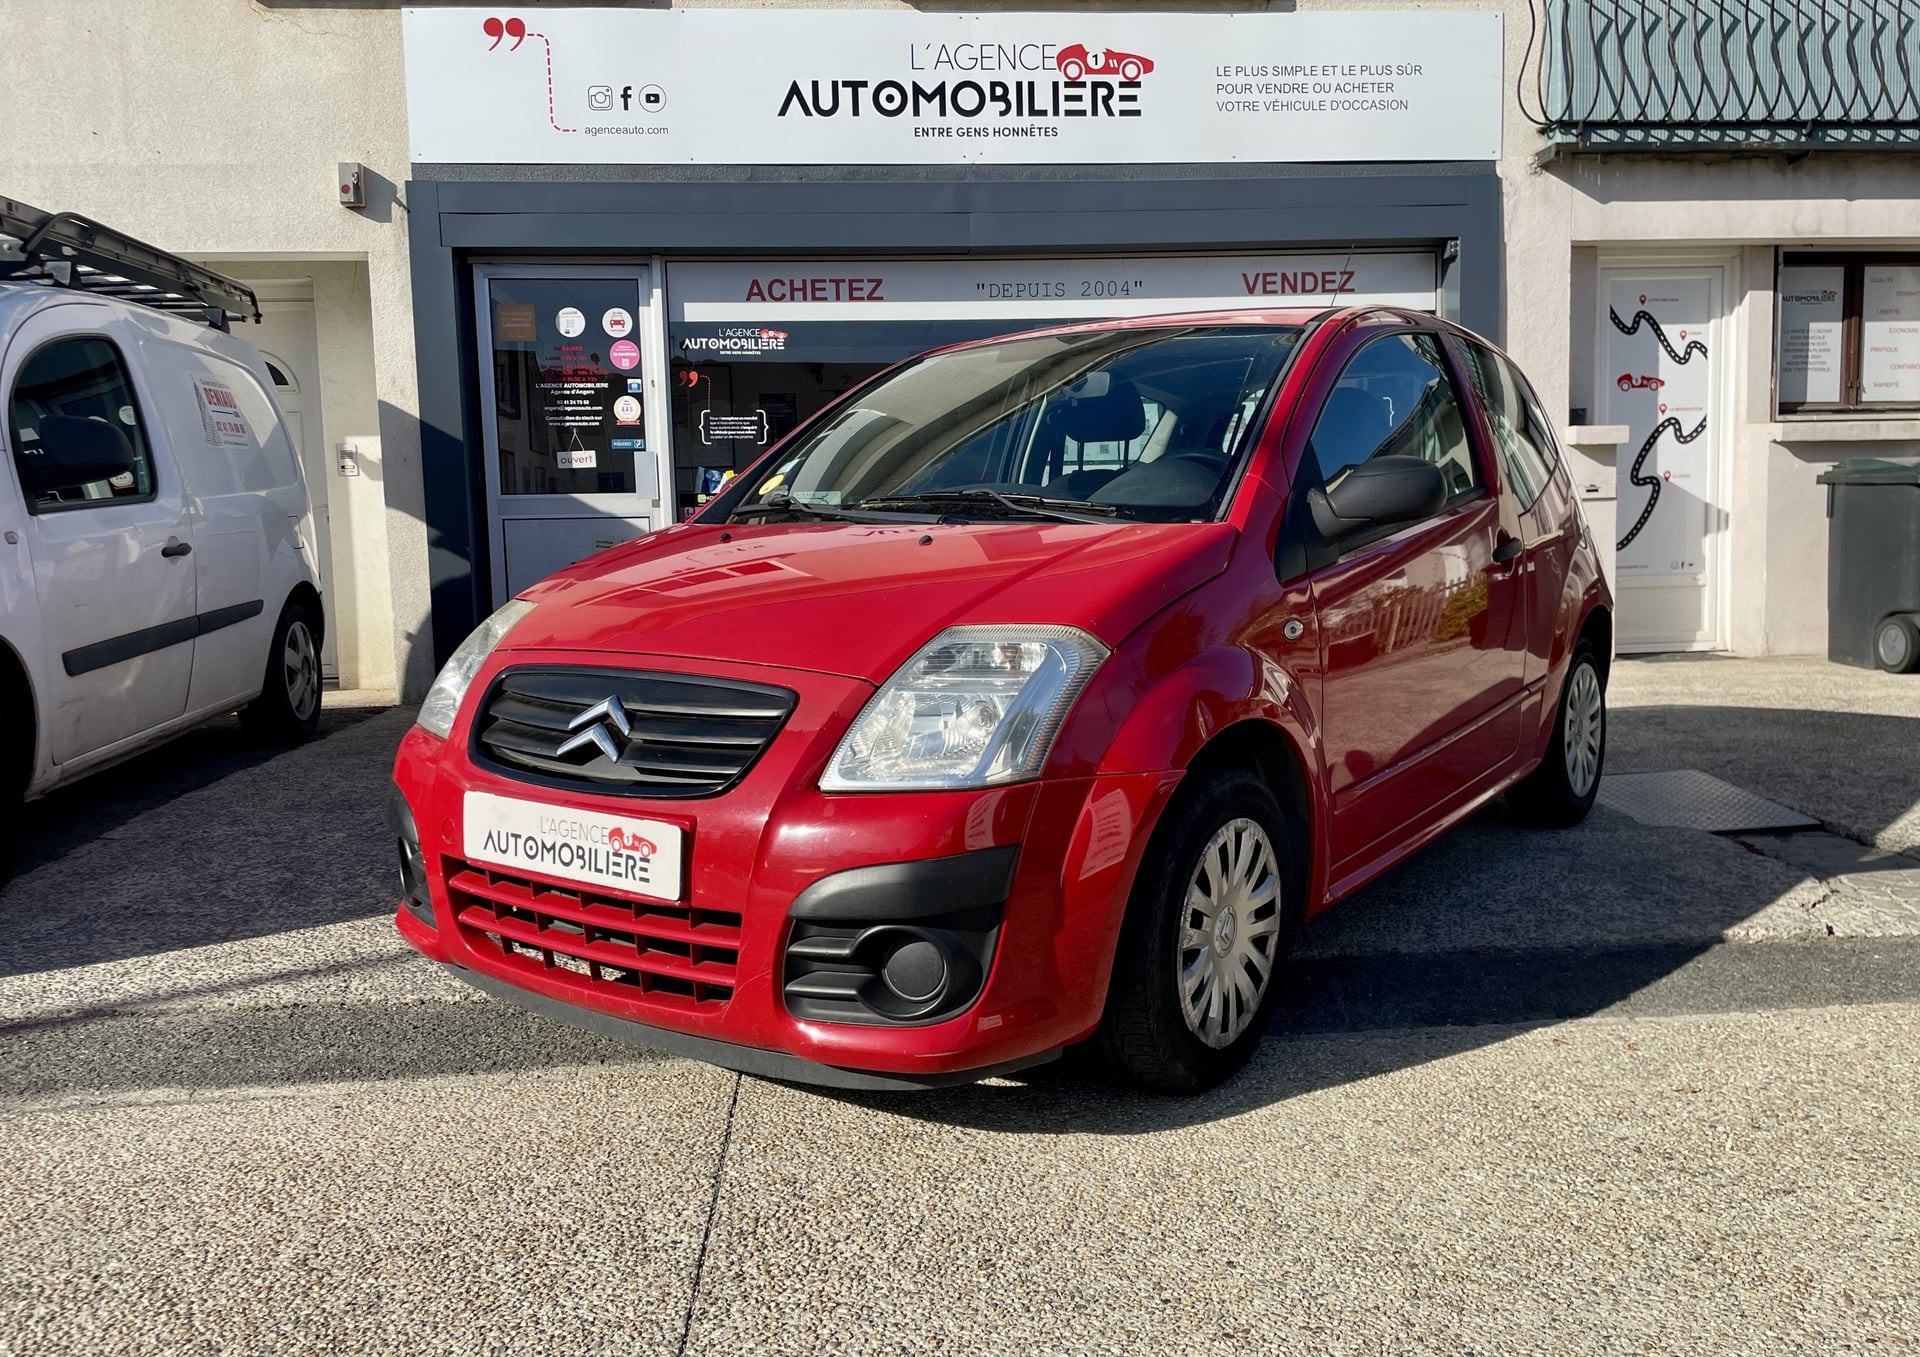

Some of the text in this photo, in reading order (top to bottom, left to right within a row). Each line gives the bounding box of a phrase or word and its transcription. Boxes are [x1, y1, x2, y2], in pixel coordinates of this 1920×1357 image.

[911, 43, 1057, 70] L'AGENCE
[1217, 63, 1423, 77] LE PLUS SIMPLE ET LE PLUS SÛR
[1216, 83, 1395, 94] POUR VENDRE OU ACHETER
[1216, 98, 1409, 112] VOTRE VÉHICULE D'OCCASION
[584, 124, 669, 137] agenceauto.com
[914, 124, 1058, 138] ENTRE GENS HONNÊTES
[745, 278, 885, 302] ACHETEZ
[976, 280, 1143, 298] "DEPUIS 2004"
[1241, 271, 1356, 295] VENDEZ
[718, 328, 761, 337] L'AGENCE
[560, 454, 593, 465] ouvert
[540, 815, 609, 846] L'AGENCE
